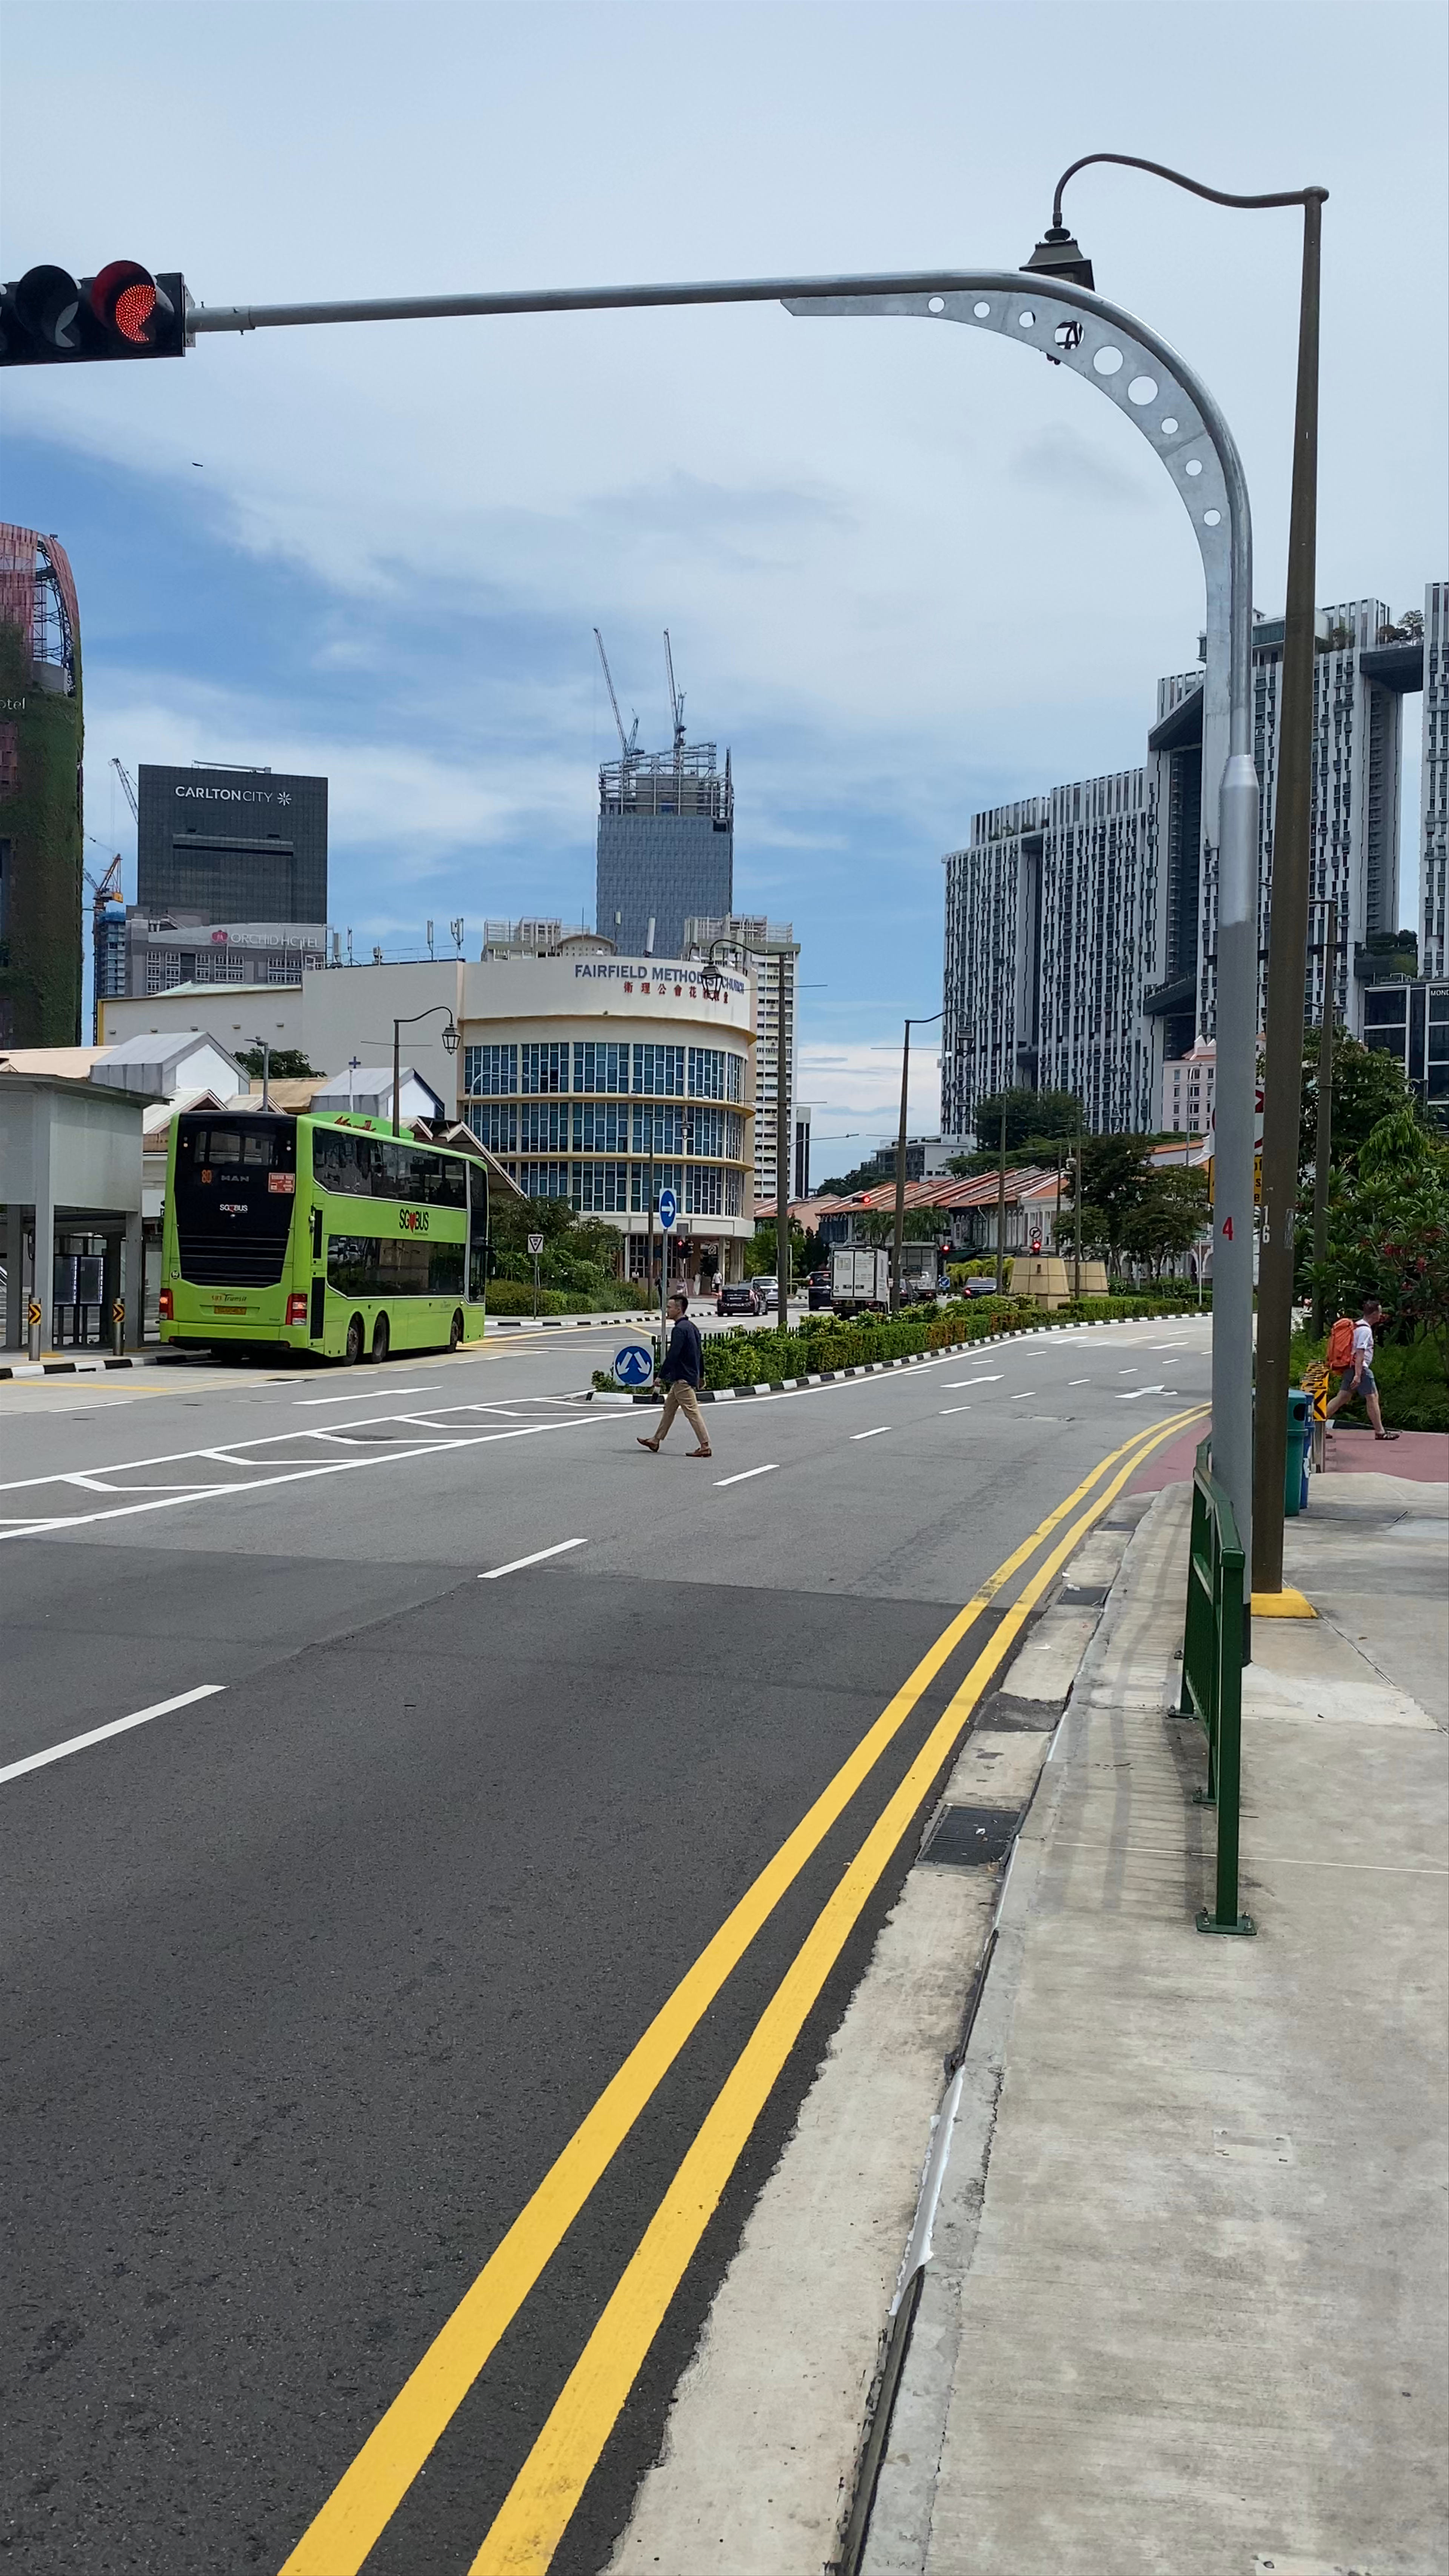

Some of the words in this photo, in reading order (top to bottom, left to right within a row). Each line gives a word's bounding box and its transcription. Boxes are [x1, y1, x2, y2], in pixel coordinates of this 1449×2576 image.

[231, 933, 279, 945] ORCHID
[281, 935, 319, 947] HOTEL
[575, 964, 648, 979] FAIRFIELD
[202, 1169, 212, 1183] 80
[1222, 1216, 1234, 1241] 4
